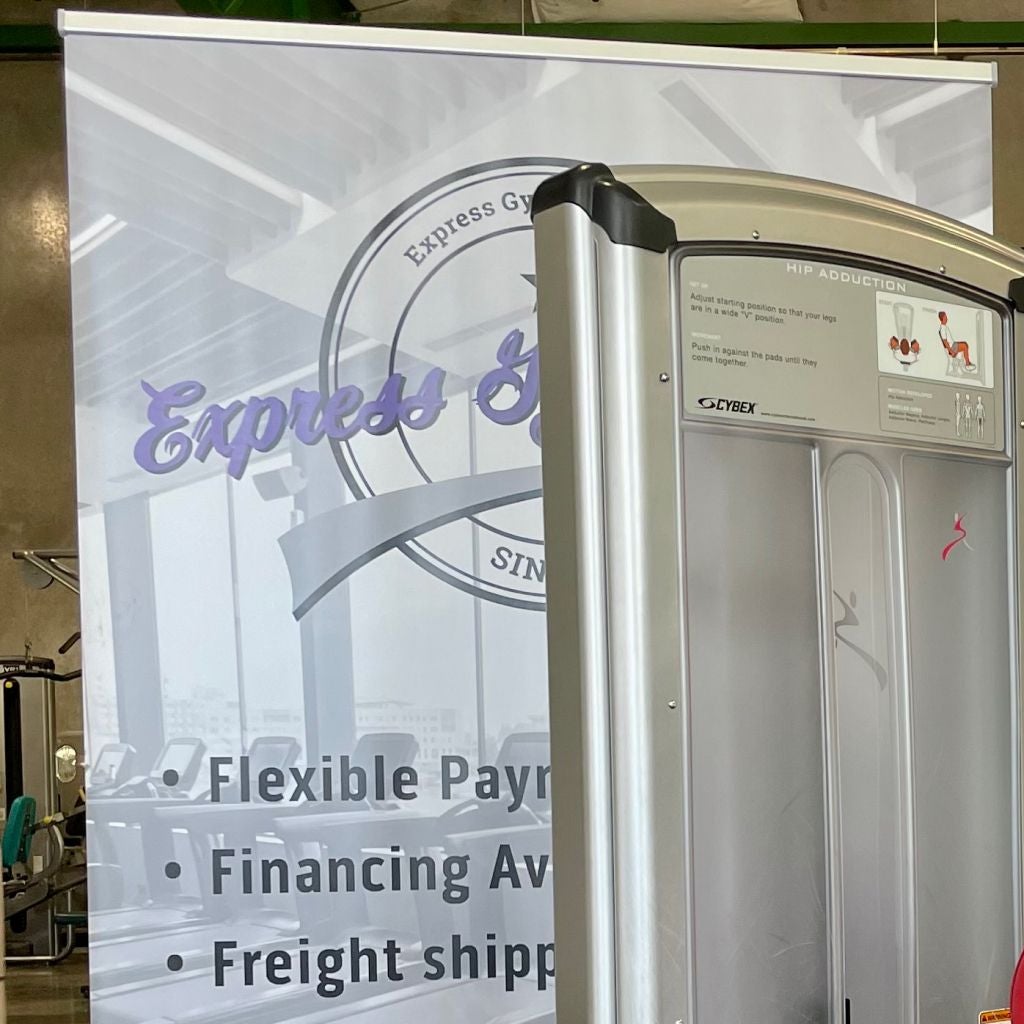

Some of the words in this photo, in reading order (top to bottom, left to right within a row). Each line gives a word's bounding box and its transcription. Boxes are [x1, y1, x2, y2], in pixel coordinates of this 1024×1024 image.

[403, 203, 495, 267] Express
[786, 262, 813, 275] HIP
[819, 268, 906, 293] ADDUCTION
[690, 293, 714, 304] Adjust
[717, 297, 745, 309] starting
[747, 302, 776, 313] position
[789, 308, 803, 317] that
[805, 312, 820, 320] your
[822, 314, 837, 323] legs
[691, 304, 702, 312] are
[722, 309, 738, 318] wide
[692, 342, 711, 352] Push
[713, 345, 720, 353] in
[723, 347, 749, 358] against
[752, 350, 763, 359] the
[765, 352, 783, 362] pads
[785, 355, 800, 364] until
[802, 358, 818, 368] they
[692, 355, 713, 364] come
[716, 399, 756, 414] CYBEX
[134, 367, 447, 480] Express
[210, 755, 418, 802] Flexible
[212, 846, 470, 904] Financing
[489, 844, 549, 888] Av
[214, 937, 404, 998] Freight
[424, 934, 555, 992] shipp
